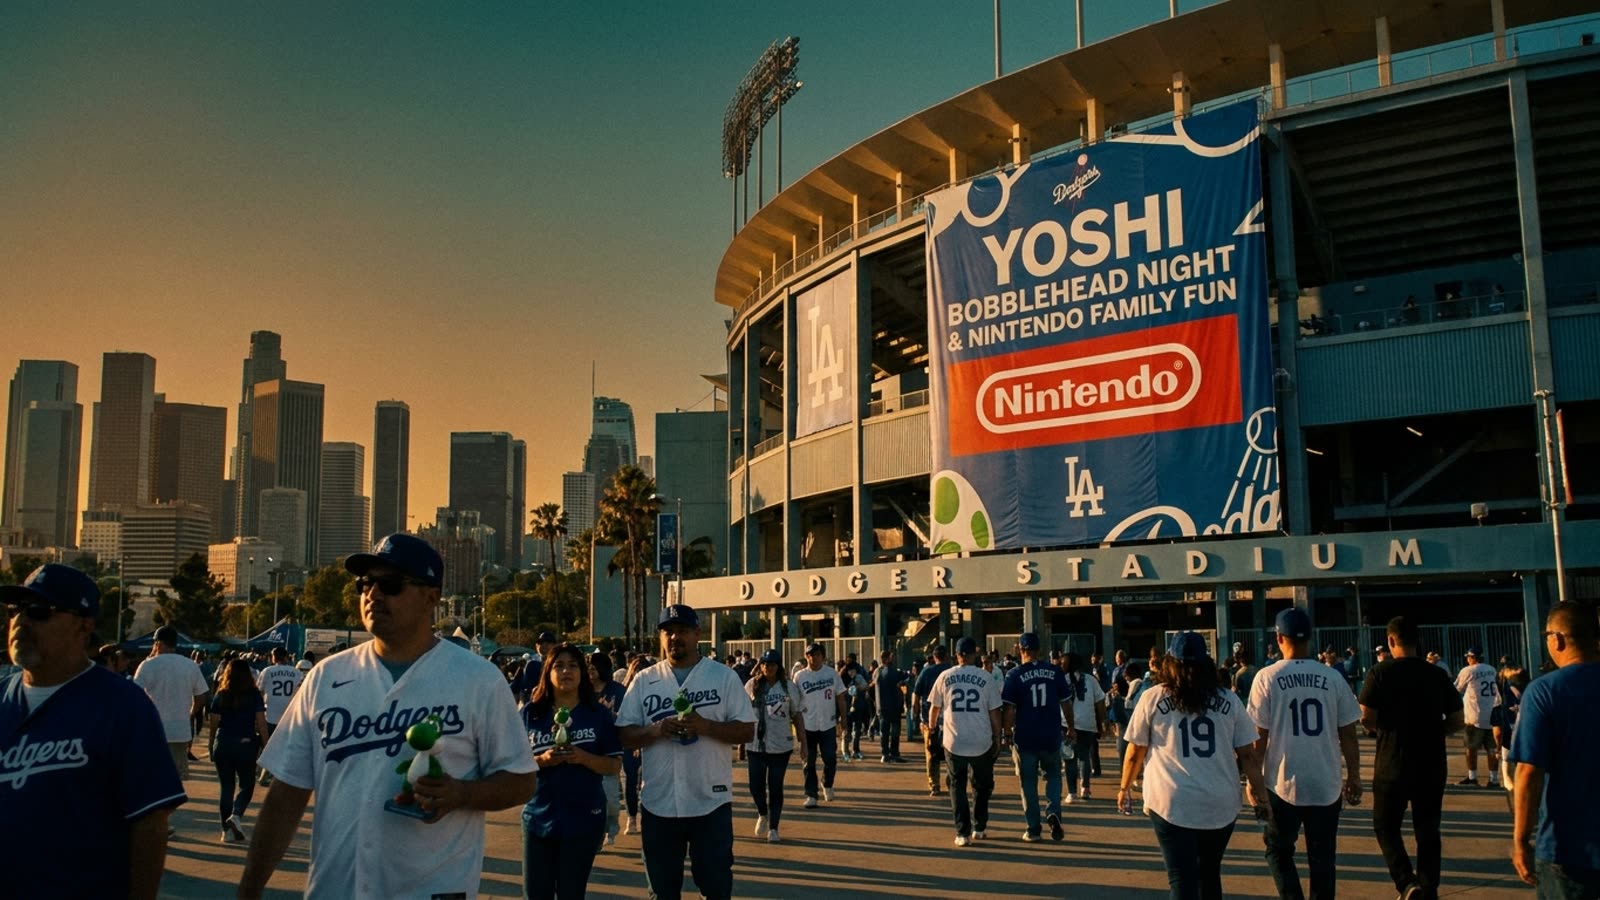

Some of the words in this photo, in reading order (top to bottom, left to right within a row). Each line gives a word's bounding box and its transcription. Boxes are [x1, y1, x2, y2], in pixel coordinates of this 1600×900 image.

[1053, 165, 1101, 206] Dodgers
[983, 188, 1184, 286] YOSHI
[948, 268, 1129, 327] BOBBLEHEAD
[1138, 244, 1236, 288] NIGHT
[948, 334, 962, 352] &
[968, 307, 1083, 347] NINTENDO
[1090, 289, 1176, 326] FAMILY
[1184, 278, 1237, 311] FUN
[808, 304, 844, 409] LA
[1065, 456, 1104, 518] LA
[738, 566, 953, 601] DODGER
[1016, 538, 1424, 585] STADIUM
[272, 680, 294, 696] 20
[952, 689, 980, 712] 22
[1030, 683, 1047, 708] 11
[1179, 716, 1216, 758] 19
[1290, 698, 1323, 736] 10
[0, 734, 89, 790] dgers
